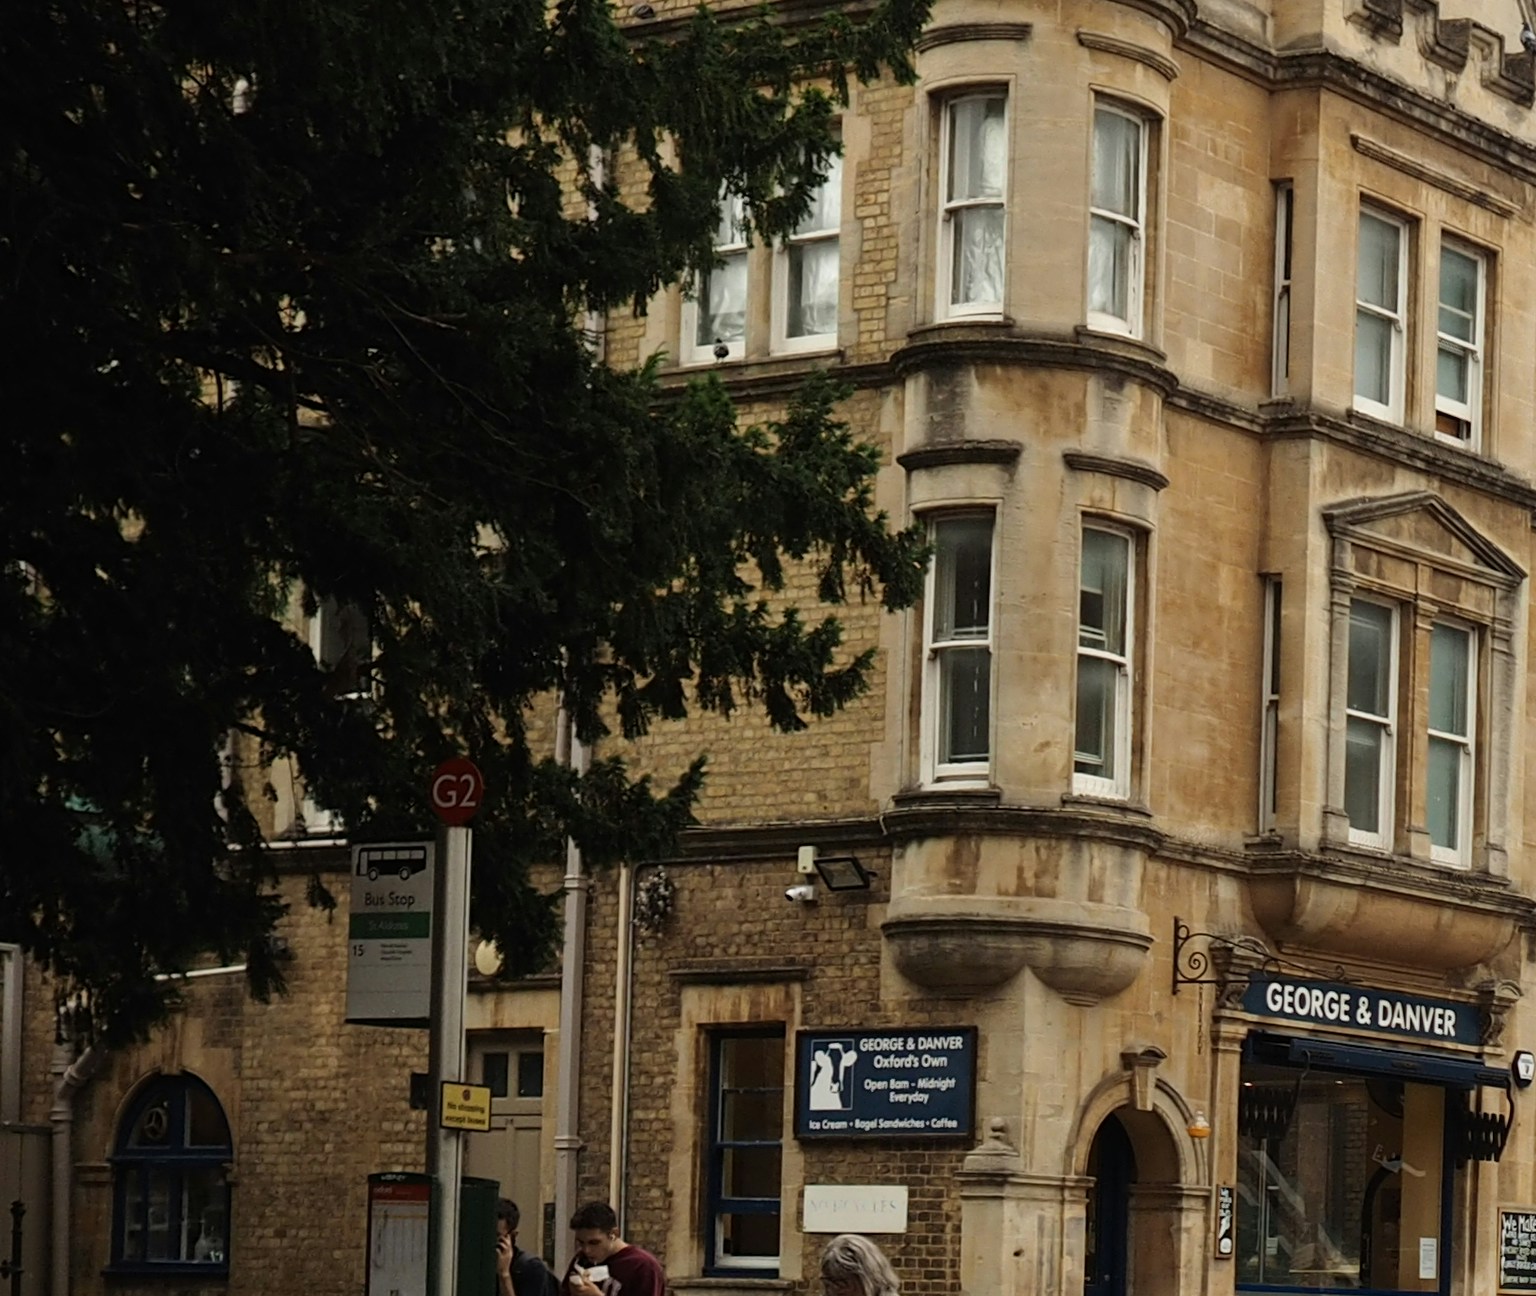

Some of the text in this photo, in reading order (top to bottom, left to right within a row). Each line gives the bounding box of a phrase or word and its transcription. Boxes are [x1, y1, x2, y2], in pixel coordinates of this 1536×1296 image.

[433, 774, 476, 808] G2
[364, 891, 416, 909] Bus Stop
[353, 945, 364, 957] 15
[1266, 982, 1456, 1037] GEORGE & DANVER
[860, 1036, 963, 1051] GEORGE & DANVER
[873, 1054, 948, 1068] Oxford's Own
[863, 1078, 888, 1092] Open
[889, 1078, 909, 1089] 8am
[917, 1077, 956, 1091] Midnight
[889, 1091, 929, 1104] Everyday
[809, 1117, 958, 1131] Ice Cream Bagel Sandwiches Coffee
[1502, 1213, 1518, 1231] We
